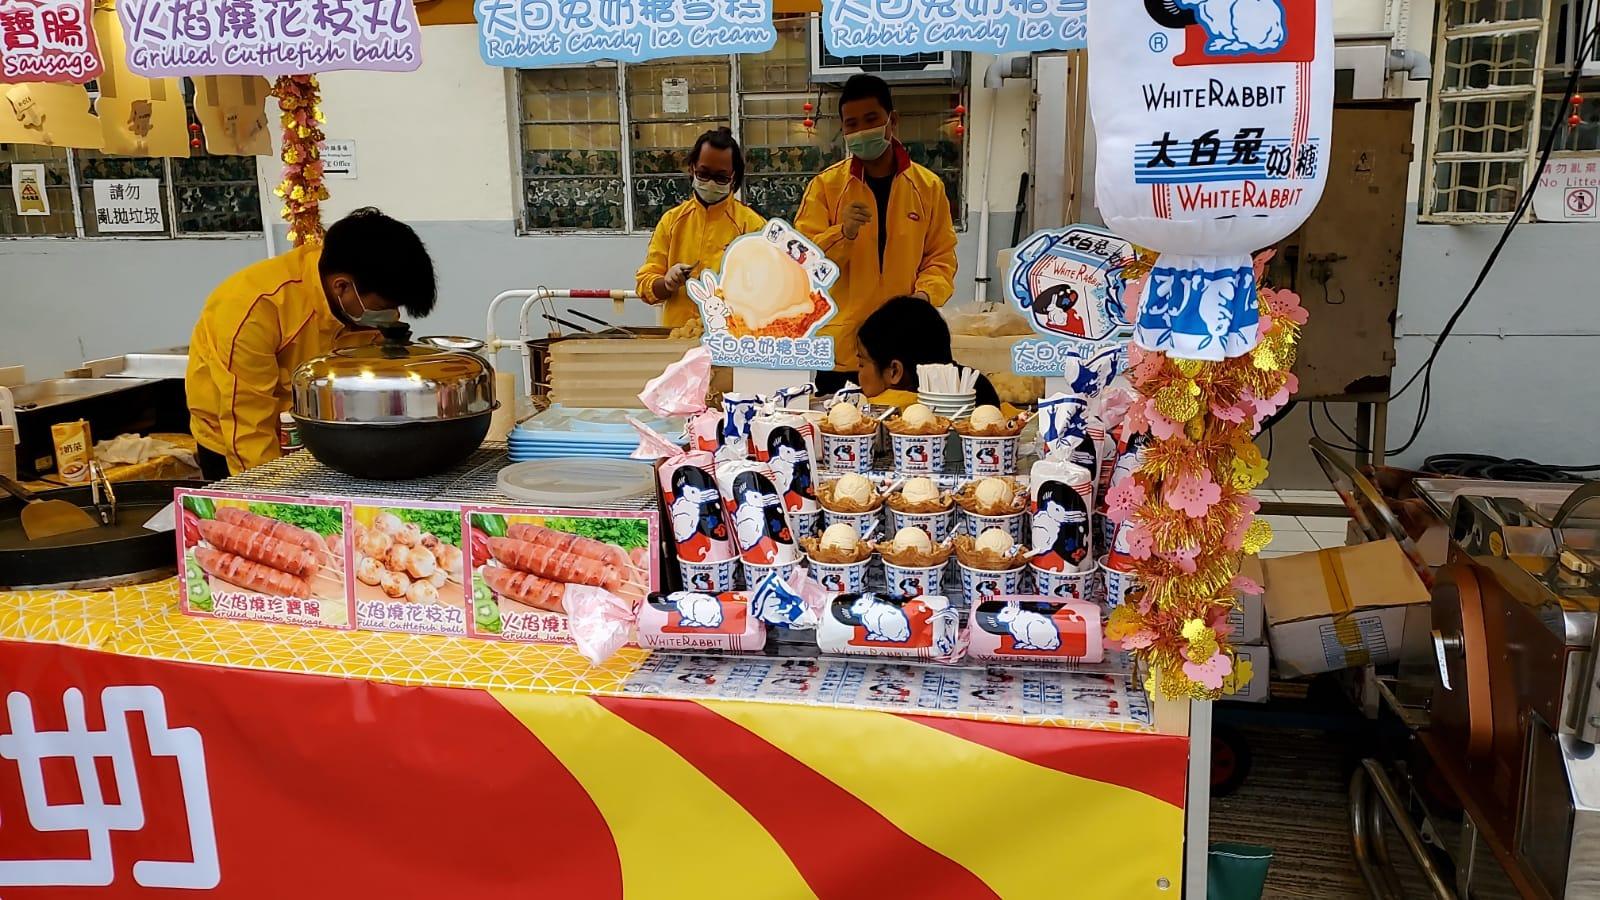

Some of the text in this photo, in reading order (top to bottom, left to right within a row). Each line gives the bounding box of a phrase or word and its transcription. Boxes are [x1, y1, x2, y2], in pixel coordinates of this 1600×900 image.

[489, 25, 768, 56] Rabbit Candy Ice Cream
[835, 25, 917, 45] Rabbit
[926, 19, 1008, 46] Candy
[1019, 18, 1053, 38] Ice
[134, 41, 413, 68] Grilled Cuttlefish balls
[6, 55, 95, 75] Sausage
[1540, 178, 1558, 187] No
[109, 183, 140, 200] 請勿
[743, 354, 776, 367] Candy
[780, 355, 793, 365] Ice
[798, 357, 831, 367] Cream
[1017, 362, 1056, 372] Rabbit
[214, 609, 324, 627] Grilled Jumbo Sausage
[357, 620, 464, 633] rilled Cuttlefish balls
[502, 631, 538, 640] Grilled
